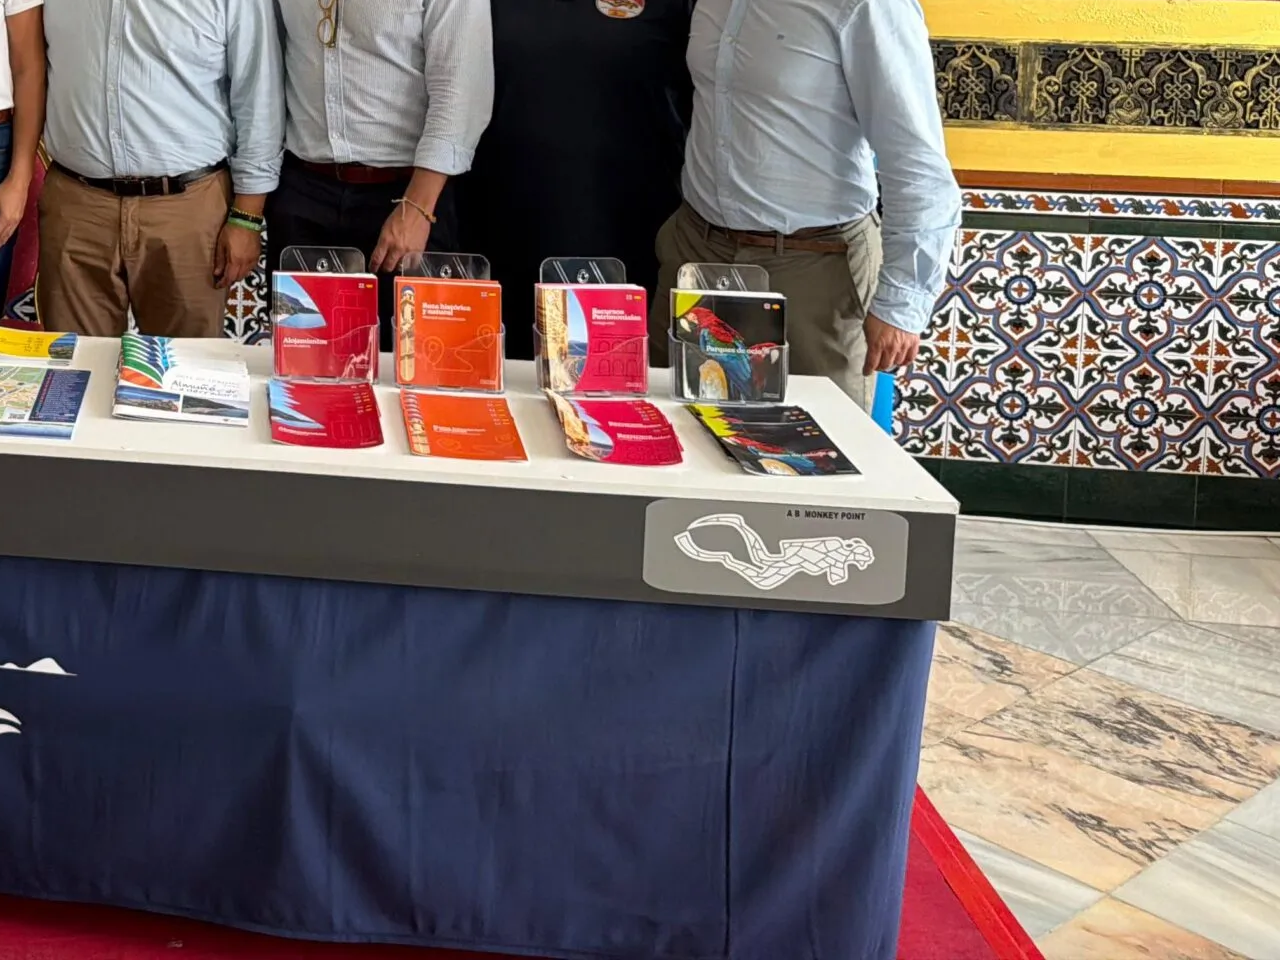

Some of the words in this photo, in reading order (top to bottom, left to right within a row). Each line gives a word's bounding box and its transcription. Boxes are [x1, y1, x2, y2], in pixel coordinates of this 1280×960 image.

[786, 509, 793, 517] A
[795, 510, 800, 518] B
[805, 510, 839, 519] MONKEY
[841, 511, 866, 520] POINT
